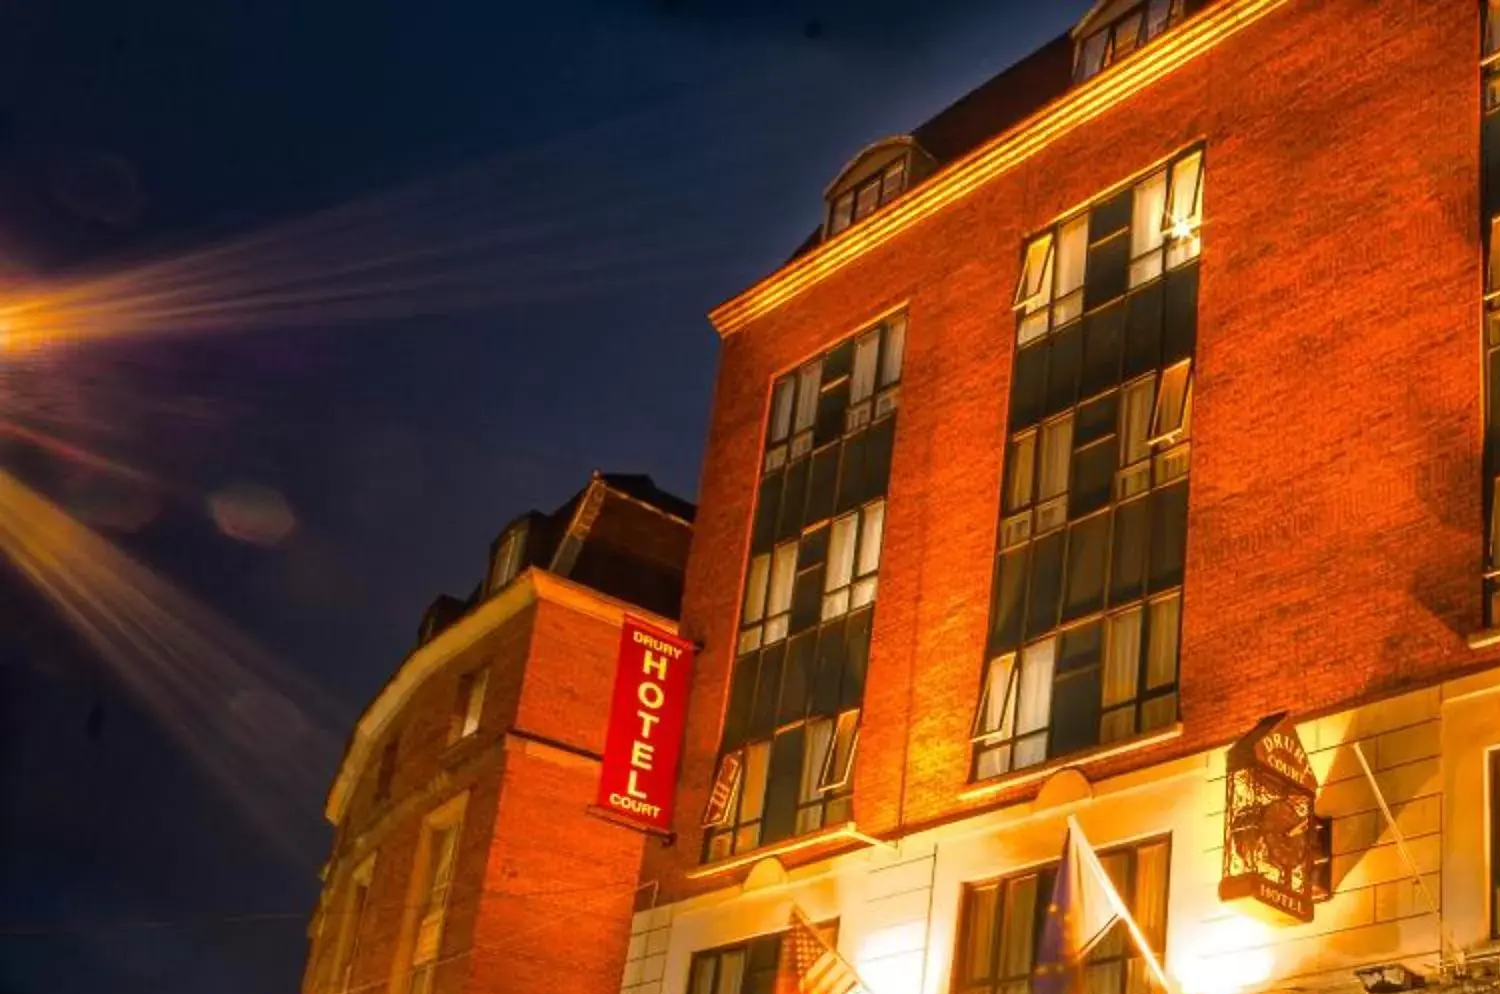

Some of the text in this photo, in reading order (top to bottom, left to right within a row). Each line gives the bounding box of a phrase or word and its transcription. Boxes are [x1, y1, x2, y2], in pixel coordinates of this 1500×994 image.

[633, 631, 683, 660] DRURY
[627, 651, 668, 800] HOTEL
[1263, 733, 1312, 775] DRURY
[1268, 755, 1305, 784] COURT
[609, 793, 662, 818] COURT
[1260, 884, 1307, 914] HOTEL
